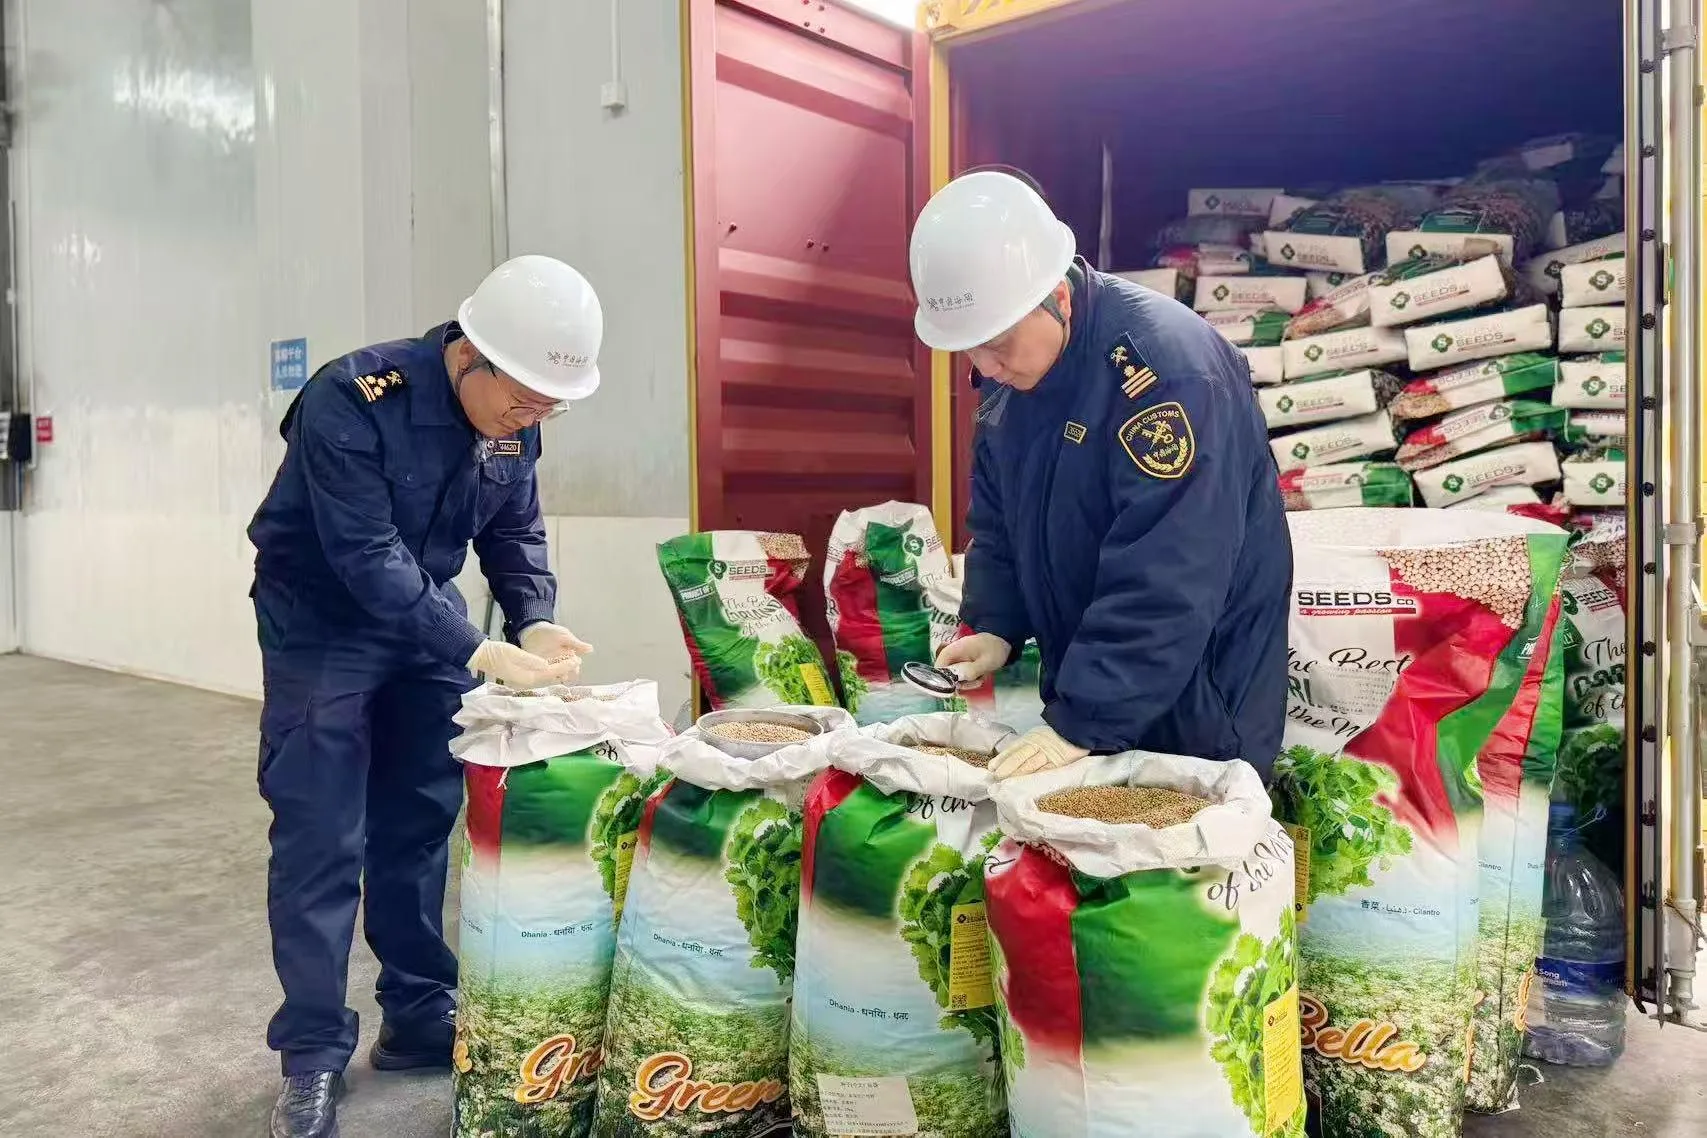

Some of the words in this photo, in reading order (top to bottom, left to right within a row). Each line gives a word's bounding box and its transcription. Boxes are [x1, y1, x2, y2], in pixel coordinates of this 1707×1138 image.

[1456, 331, 1504, 347] SEEDS
[1125, 421, 1143, 442] CHINA
[1142, 410, 1180, 424] CUSTOMS
[1466, 465, 1514, 485] SEEDS
[729, 565, 767, 576] SEEDS
[1298, 591, 1392, 607] SEEDS
[1576, 588, 1617, 605] SEEDS
[1329, 647, 1411, 675] Best
[1584, 694, 1605, 719] of
[1207, 871, 1241, 911] of
[1361, 898, 1380, 911] 香菜
[1413, 908, 1441, 916] Cilantro
[521, 930, 548, 938] Dhania
[653, 933, 676, 947] Dhania
[829, 998, 855, 1013] Dhania
[629, 1051, 787, 1120] Green
